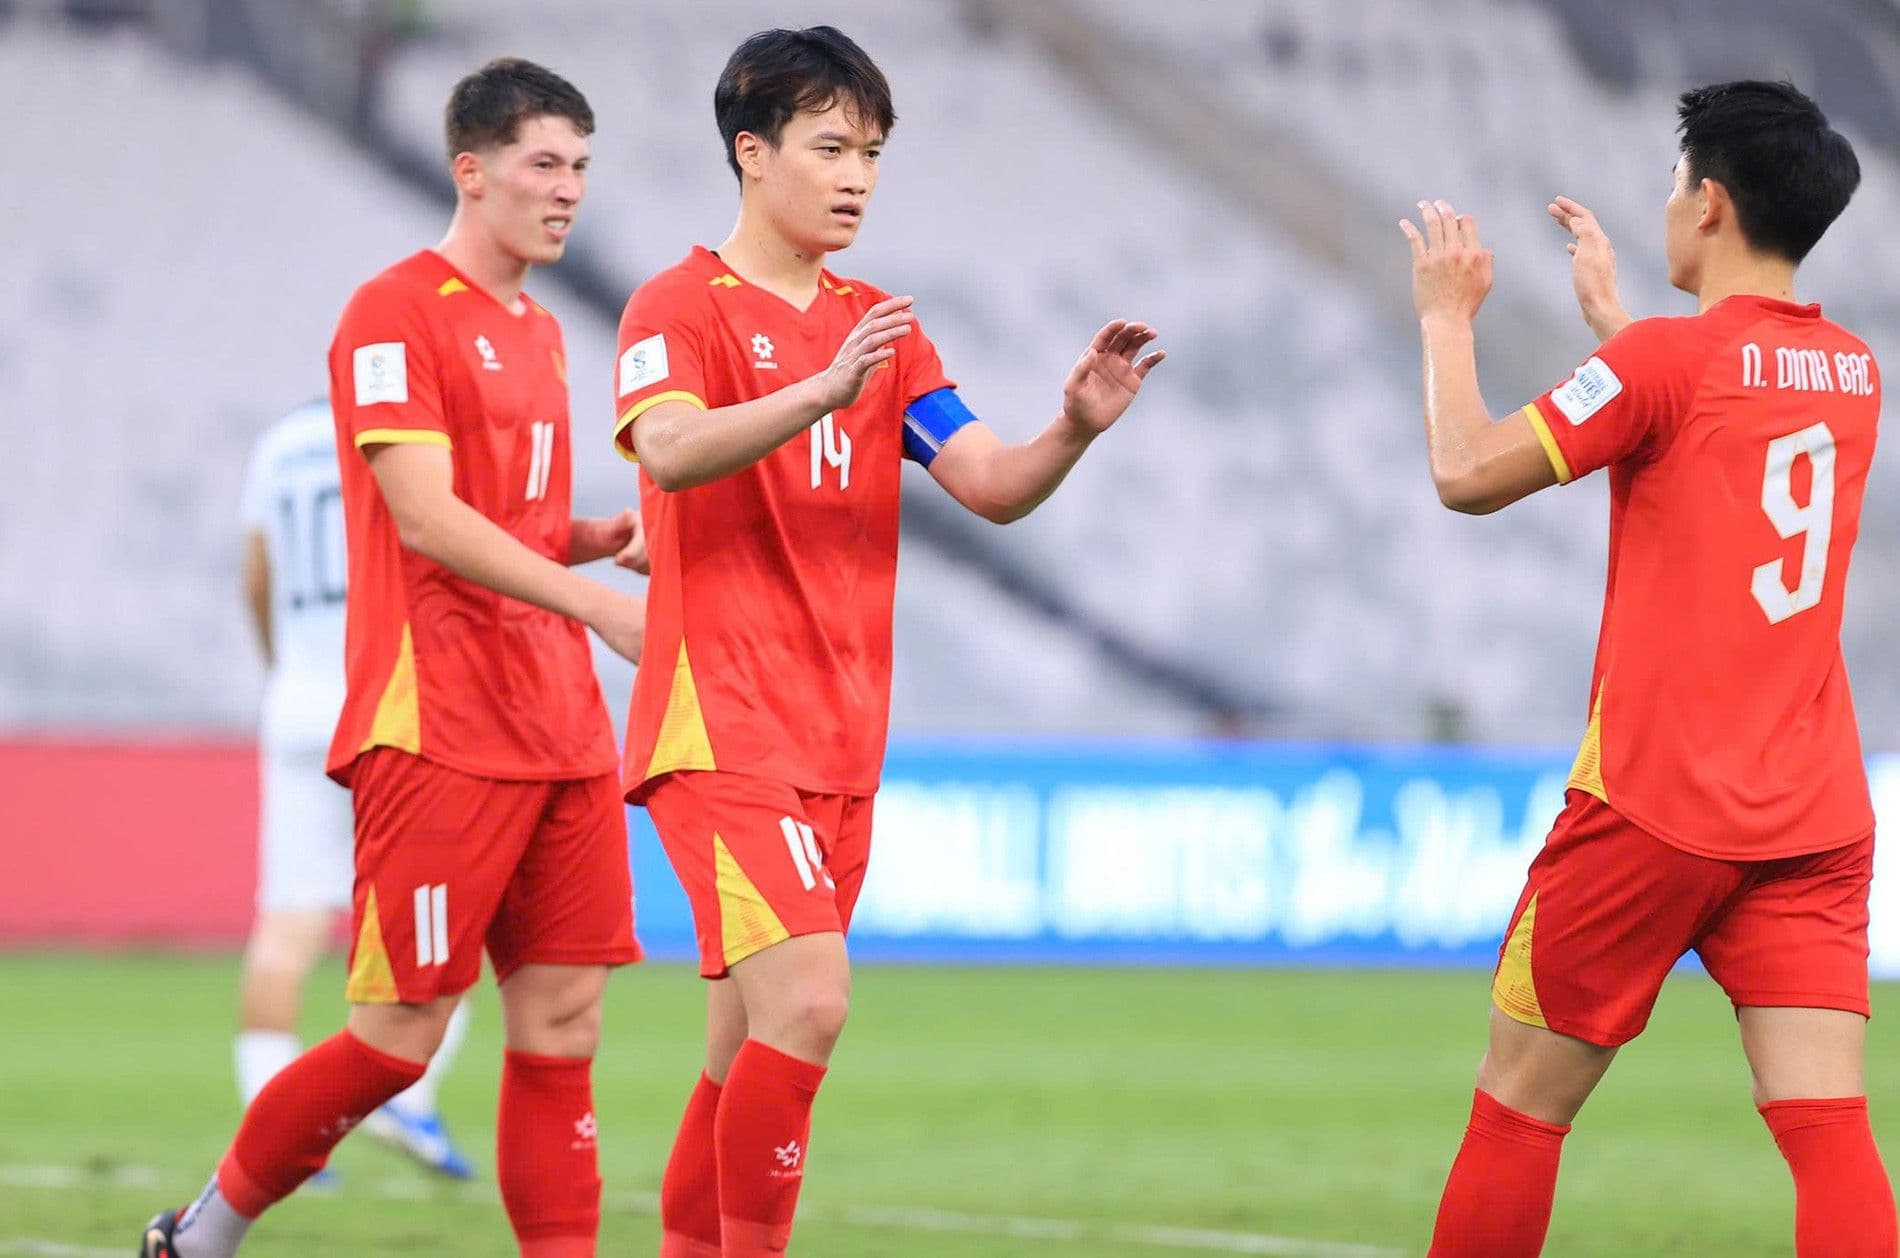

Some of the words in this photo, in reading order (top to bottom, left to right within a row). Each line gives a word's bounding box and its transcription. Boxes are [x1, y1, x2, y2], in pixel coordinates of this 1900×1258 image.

[1775, 346, 1834, 392] DINH
[1833, 351, 1874, 396] BAC
[524, 420, 555, 502] 11
[809, 411, 852, 491] 14
[1750, 421, 1838, 625] 9
[414, 883, 450, 968] 11
